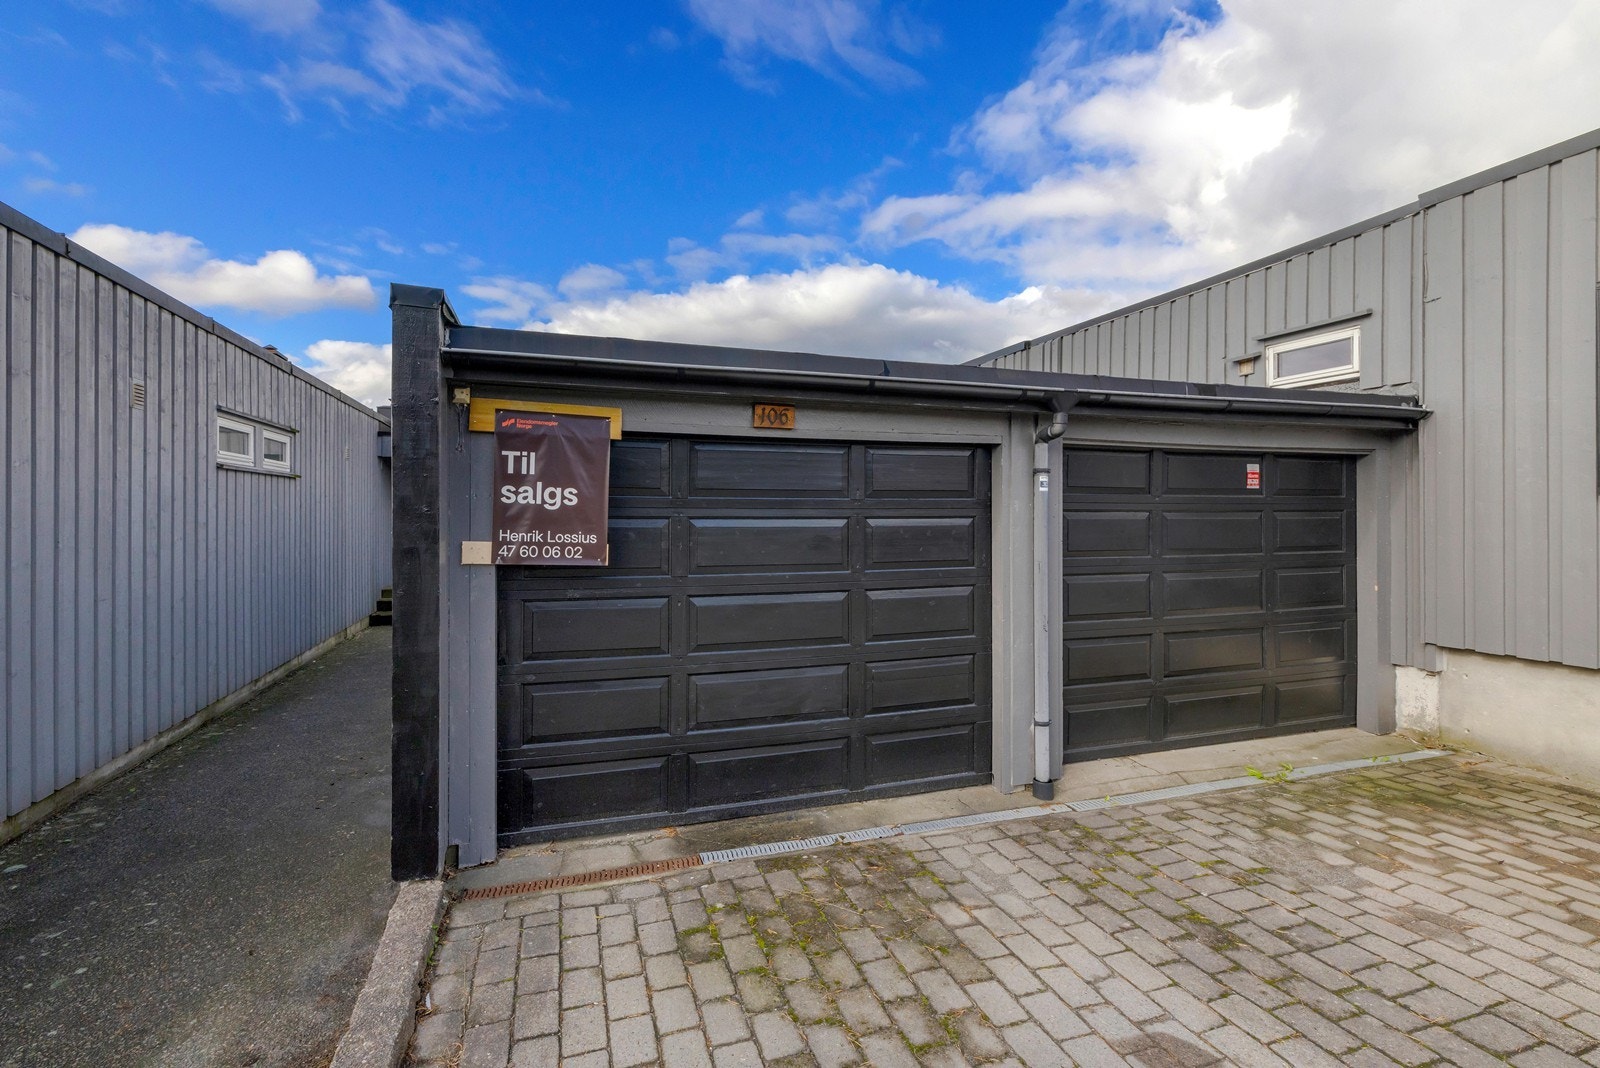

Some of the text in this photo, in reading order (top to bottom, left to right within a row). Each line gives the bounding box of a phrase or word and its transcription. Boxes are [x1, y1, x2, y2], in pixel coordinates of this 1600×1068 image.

[760, 407, 790, 425] 106
[501, 450, 536, 475] Til
[500, 481, 578, 510] salgs
[499, 529, 597, 544] Henrik Lossius
[498, 545, 583, 559] 47 60 06 02
